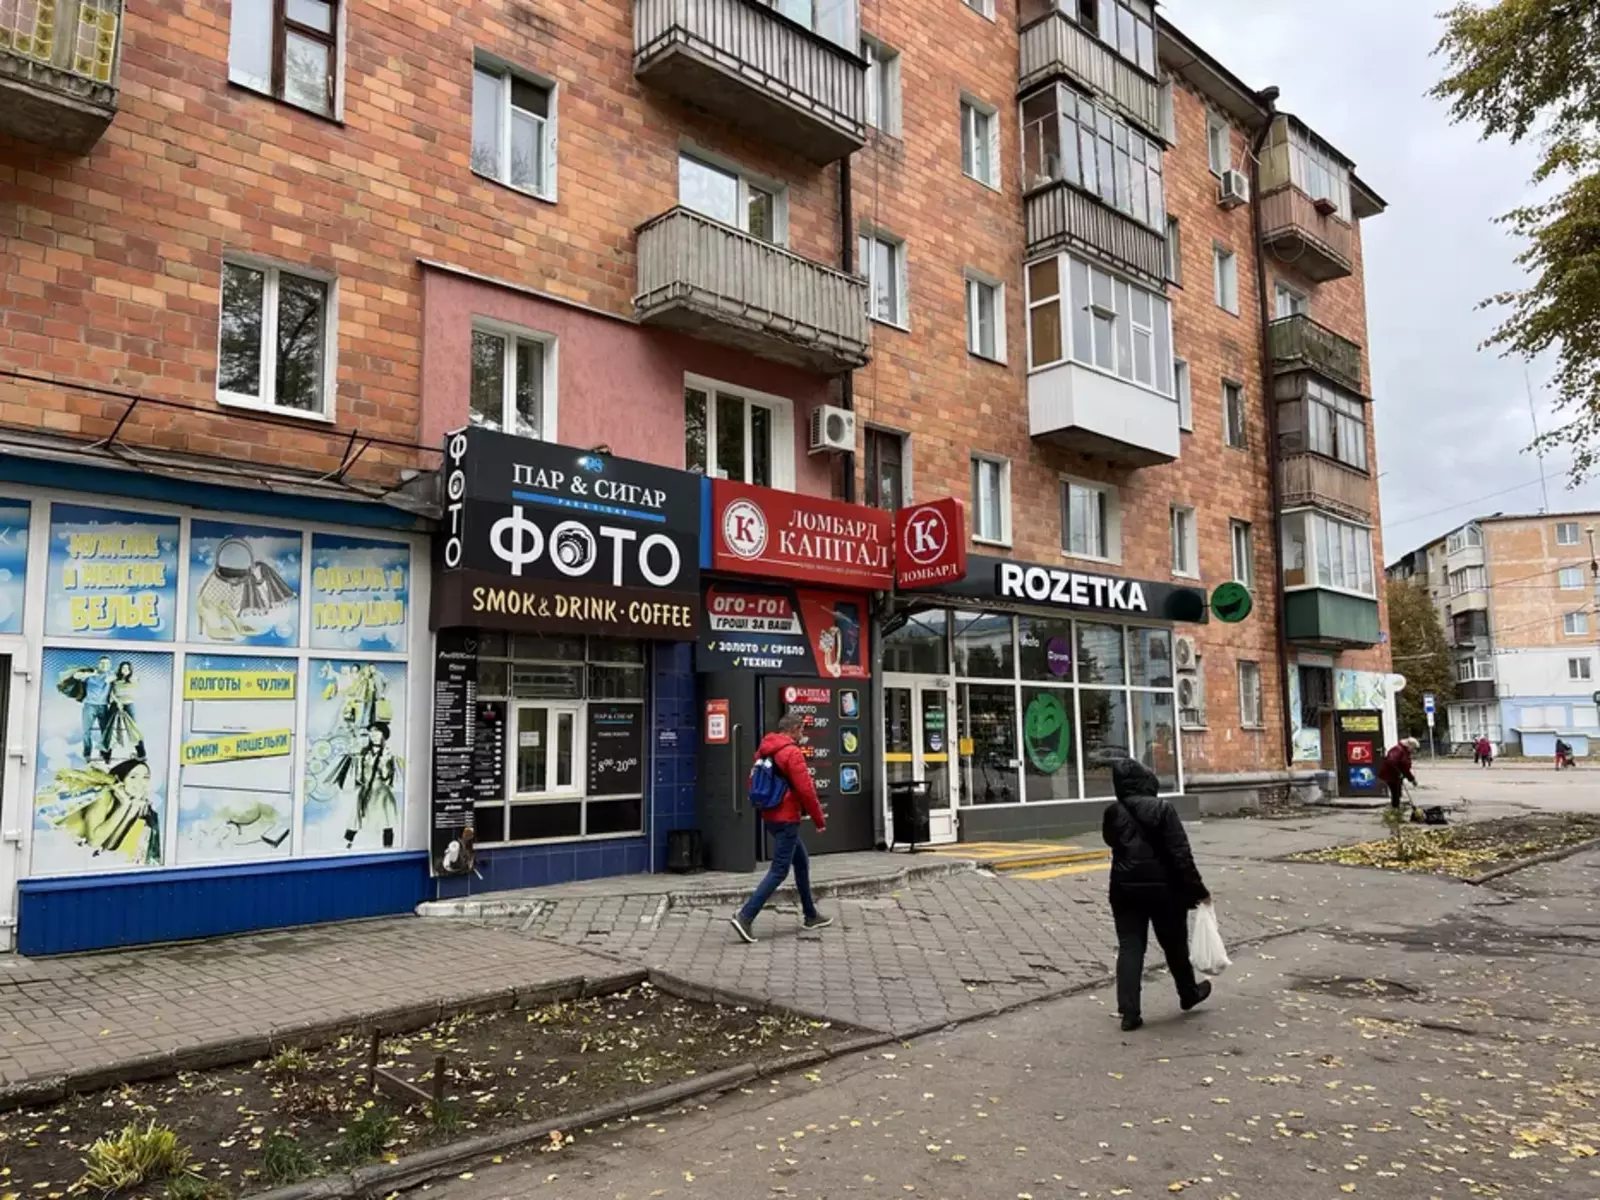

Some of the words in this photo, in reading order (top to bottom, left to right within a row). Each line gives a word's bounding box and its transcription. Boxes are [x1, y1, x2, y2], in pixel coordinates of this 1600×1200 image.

[512, 463, 565, 491] ПАР
[570, 475, 588, 496] &
[594, 479, 667, 508] СИГАР
[445, 433, 467, 569] ФОТО
[788, 509, 879, 542] ЛОМБАРД
[489, 505, 681, 587] ФОТО
[778, 530, 888, 568] КАПІТАЛ
[900, 563, 959, 584] ЛОМБАРД
[1000, 562, 1148, 611] ROZETKA
[70, 594, 160, 632] БЕЛЬЕ
[628, 601, 692, 627] COFFEE
[716, 617, 749, 630] ГРОШІ
[751, 618, 765, 630] ЗА
[768, 619, 792, 631] ВАШІ
[718, 642, 758, 653] ЗОЛОТО
[771, 644, 804, 656] СРІБЛО
[742, 657, 783, 668] ТЕХНІКУ
[189, 677, 241, 691] КОЛГОТЫ
[256, 678, 291, 691] ЧУЛКИ
[186, 743, 218, 760] СУМКИ
[236, 734, 288, 753] КОШЕЛЬКИ
